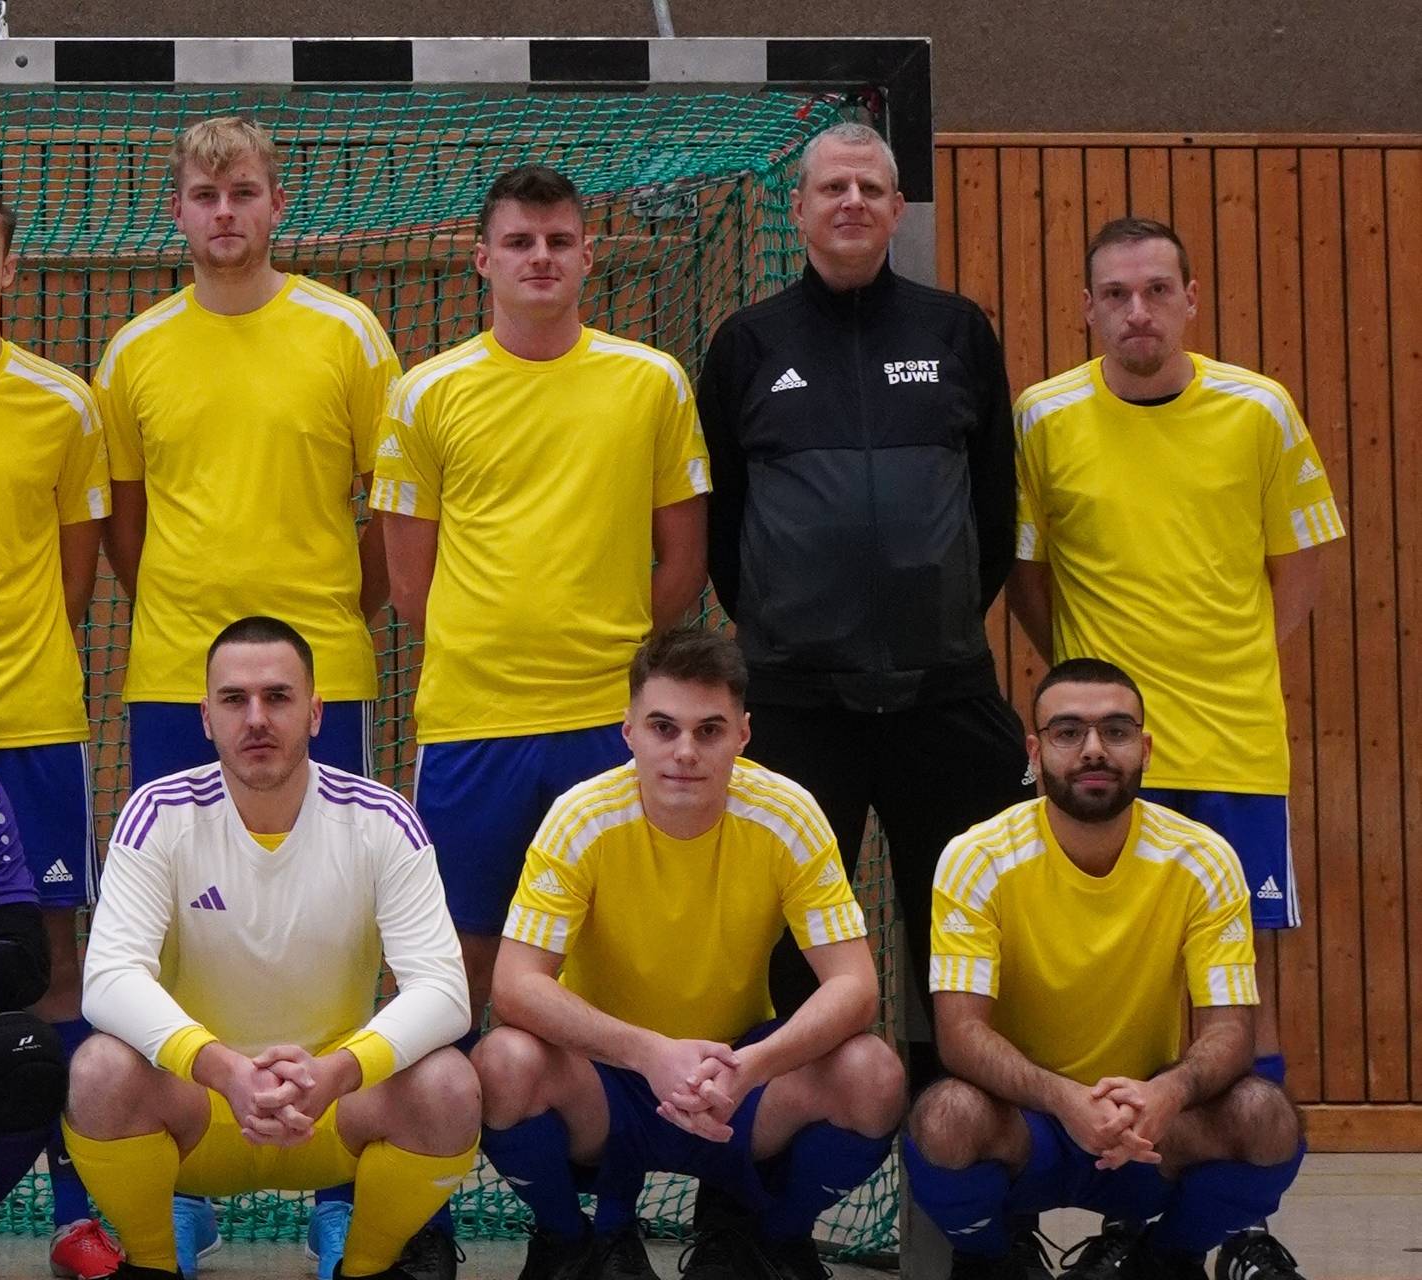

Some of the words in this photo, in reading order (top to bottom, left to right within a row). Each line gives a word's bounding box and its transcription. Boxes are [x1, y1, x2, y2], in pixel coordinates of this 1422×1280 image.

[883, 360, 940, 374] SPORT
[888, 371, 940, 385] DUWE
[771, 380, 808, 392] adidas
[43, 873, 73, 883] adidas
[1257, 890, 1283, 900] adidas
